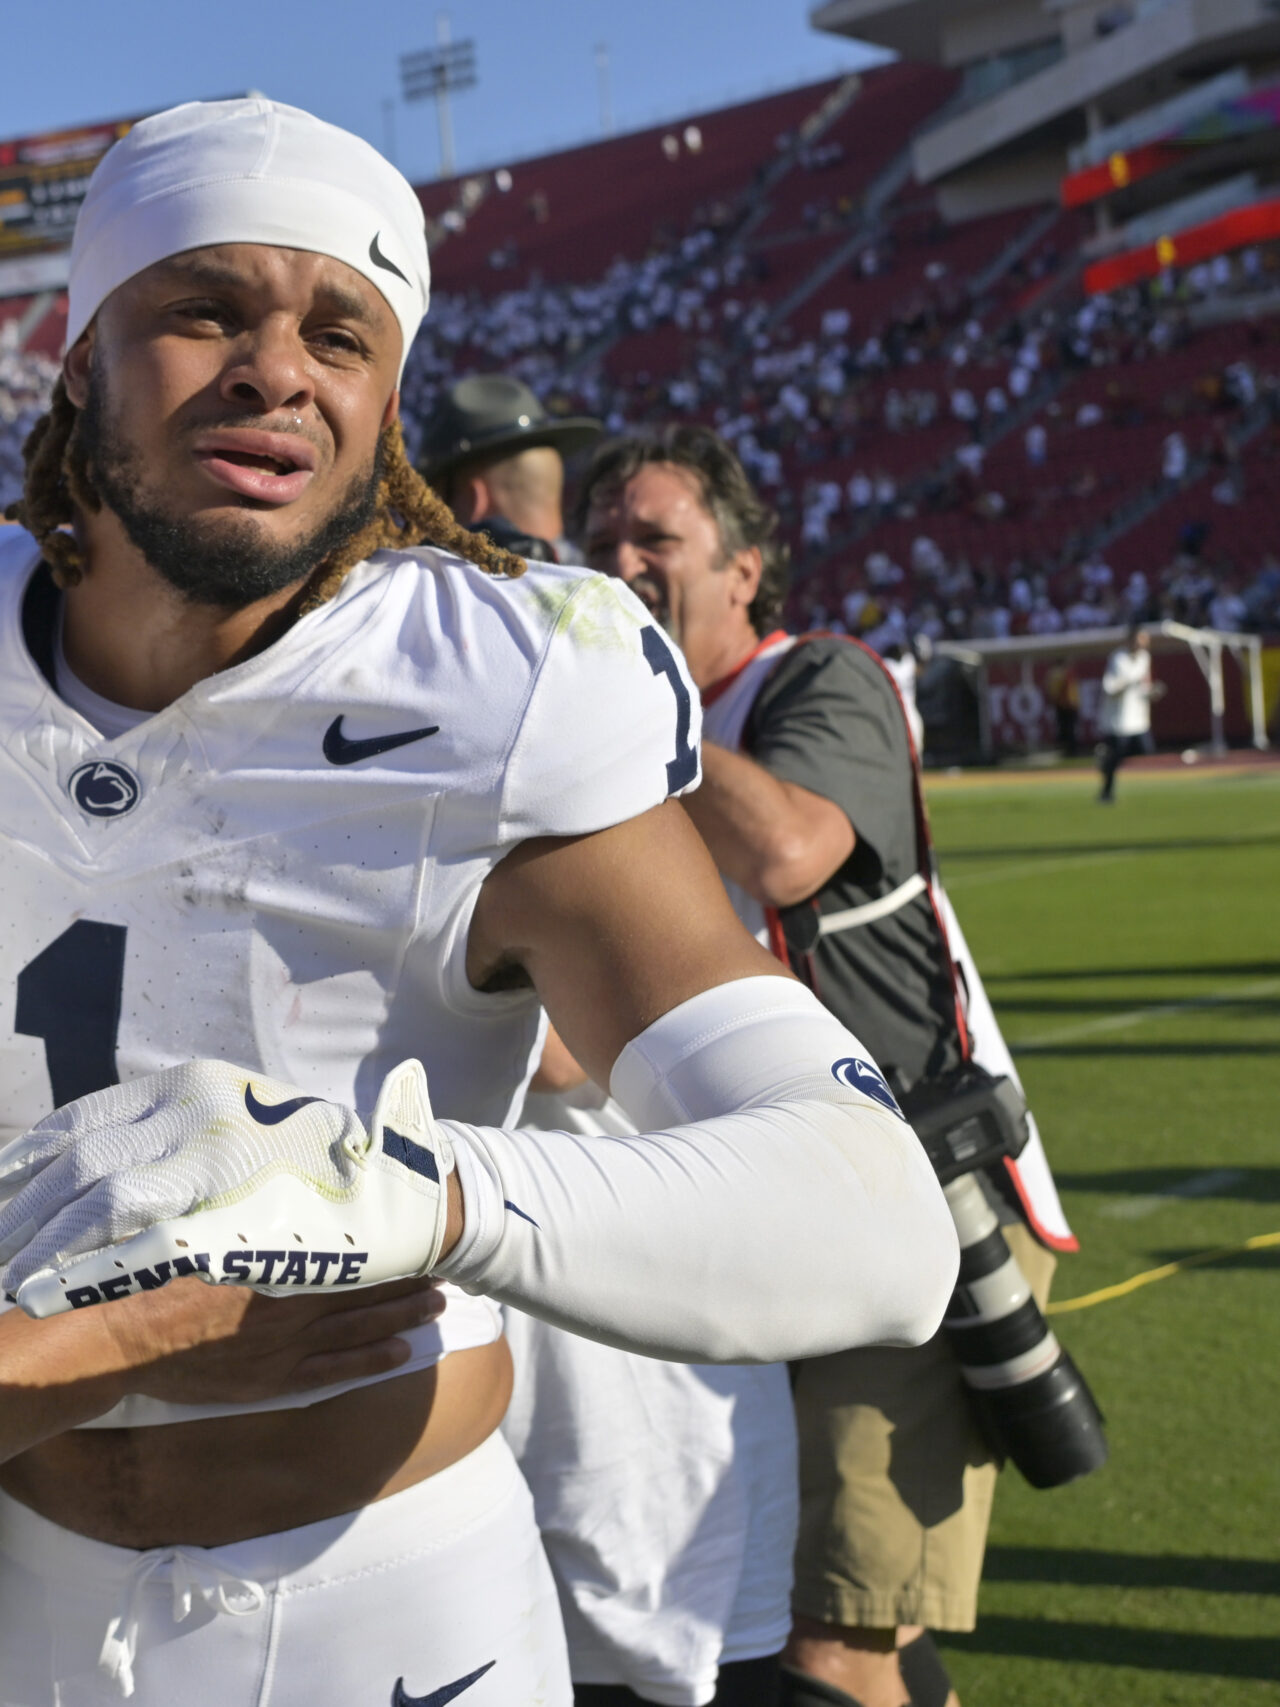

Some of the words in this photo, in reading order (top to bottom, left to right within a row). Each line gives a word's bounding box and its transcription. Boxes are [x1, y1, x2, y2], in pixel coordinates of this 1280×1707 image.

[640, 625, 698, 796] 1
[14, 918, 128, 1110] 1
[220, 1250, 368, 1285] STATE
